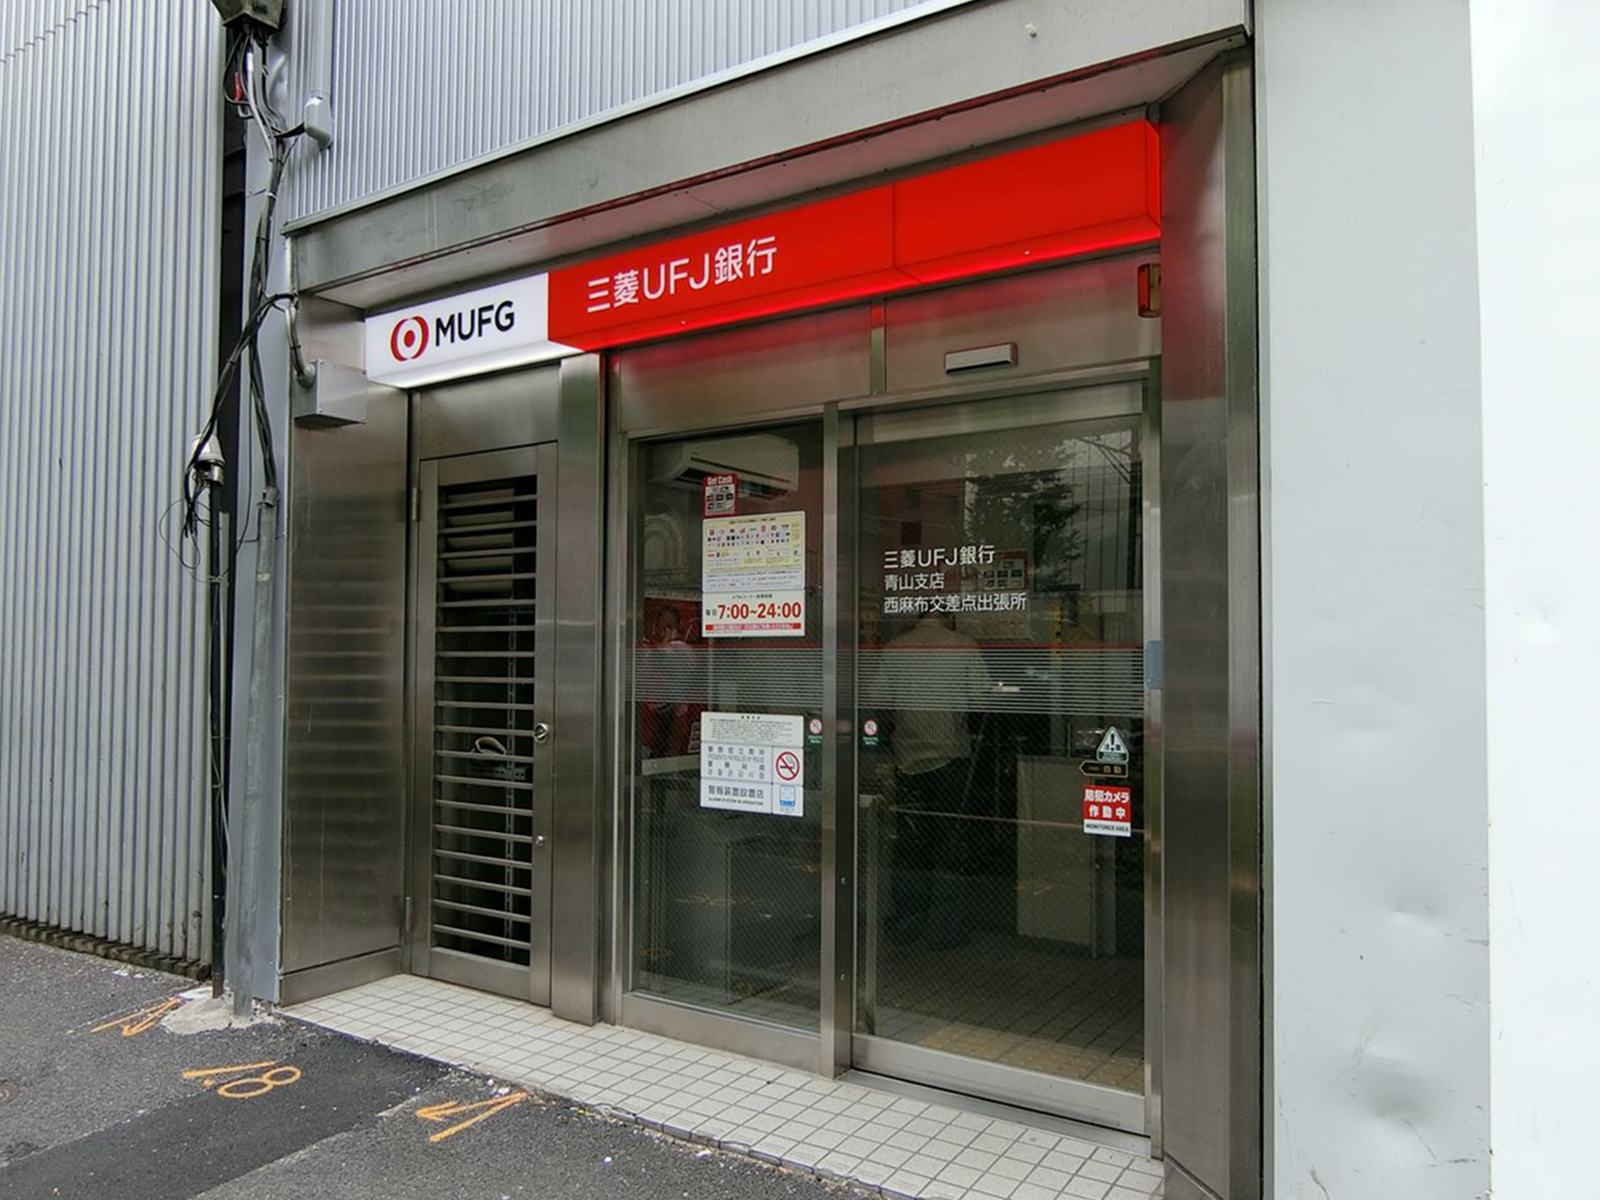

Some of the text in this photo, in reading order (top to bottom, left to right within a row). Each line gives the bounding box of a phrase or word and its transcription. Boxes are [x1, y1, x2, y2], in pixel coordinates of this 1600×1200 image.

[586, 236, 778, 314] 三菱UFJ銀行
[435, 300, 515, 347] MUFG
[884, 545, 995, 568] 三菱UFJ銀行
[884, 572, 945, 591] 青山支店
[884, 592, 1027, 613] 西麻布交差点出張所
